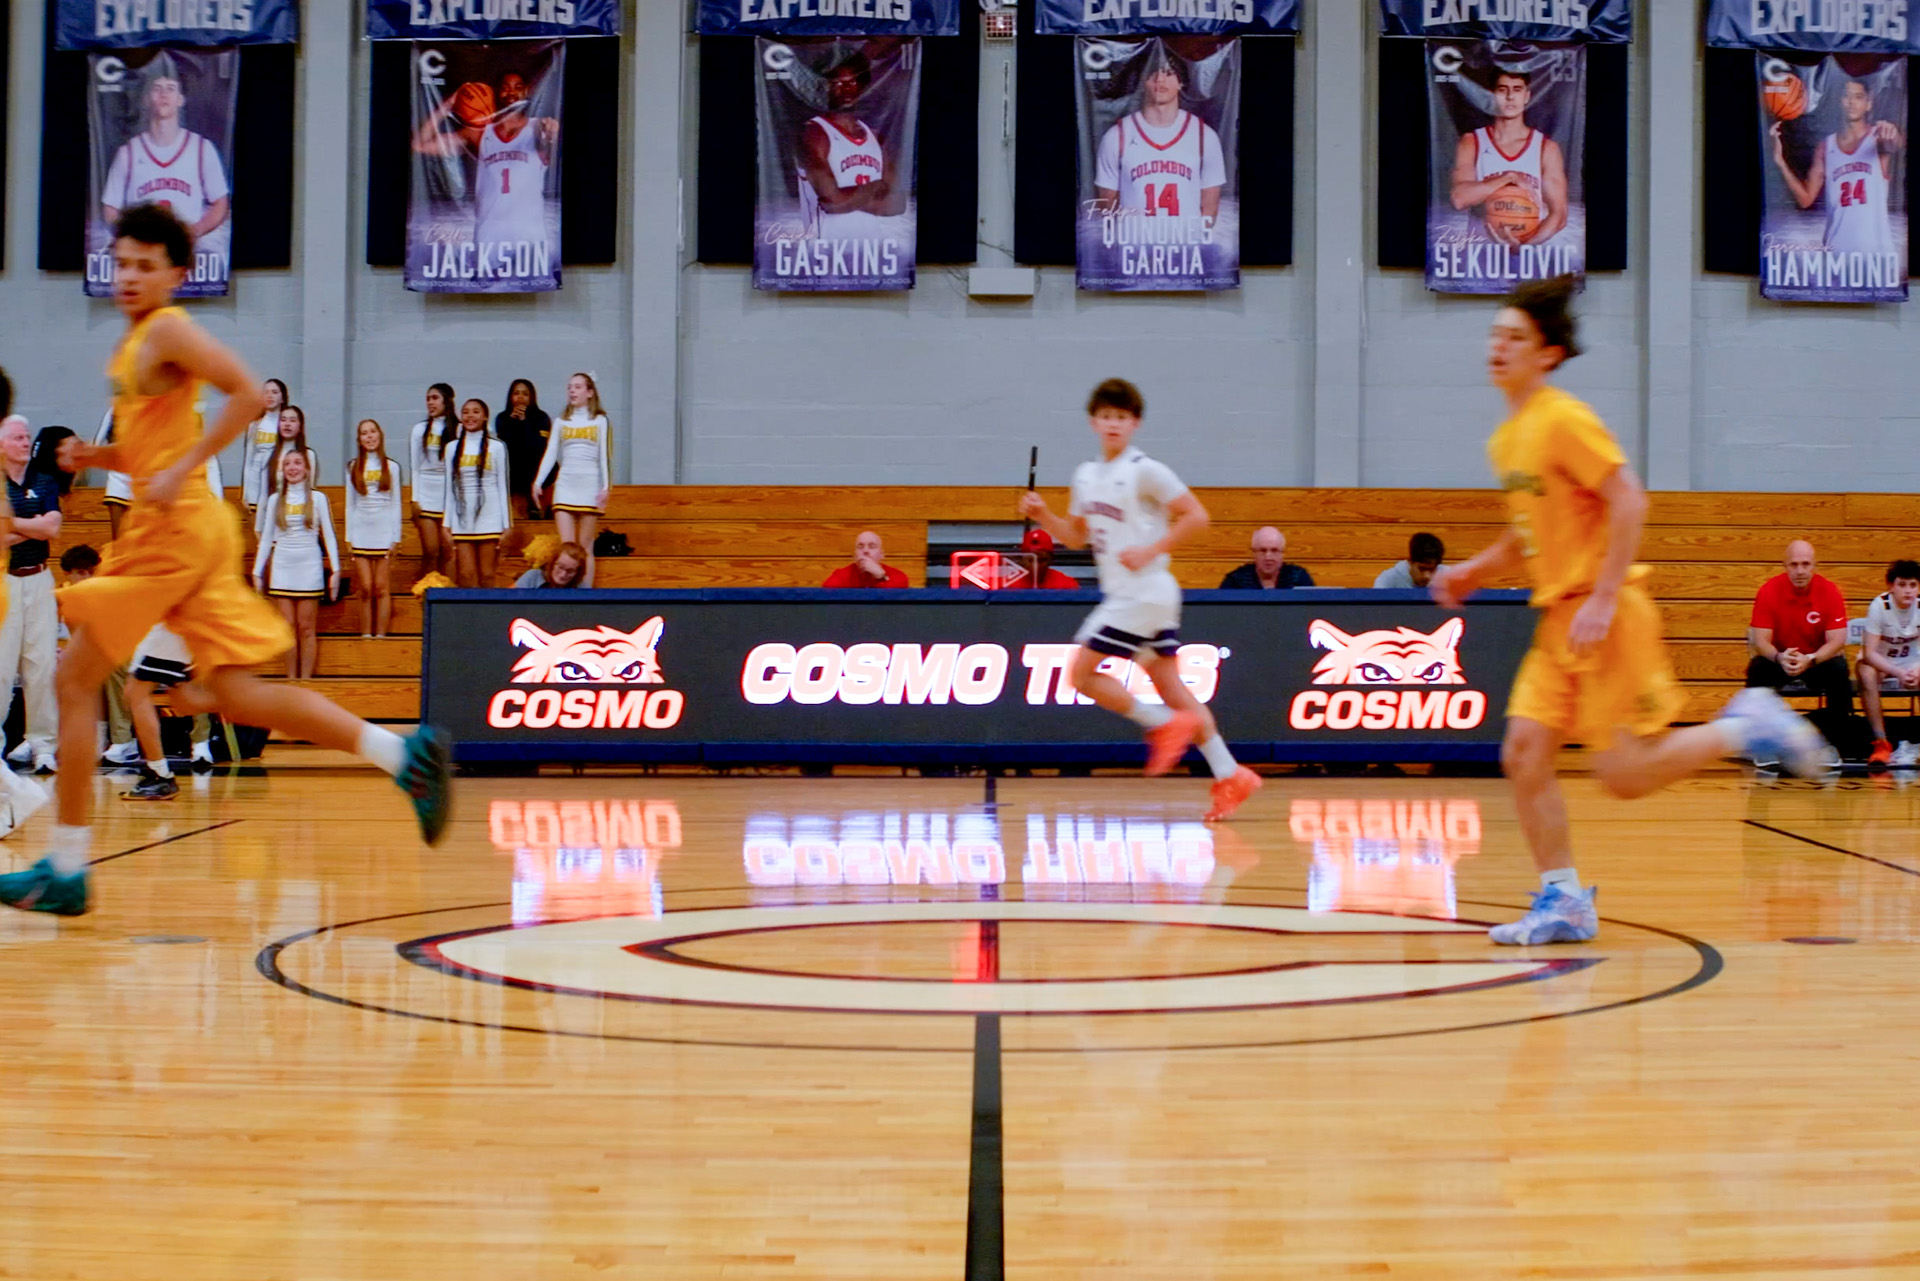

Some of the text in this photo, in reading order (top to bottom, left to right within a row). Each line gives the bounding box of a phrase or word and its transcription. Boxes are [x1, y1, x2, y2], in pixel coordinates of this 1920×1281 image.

[95, 0, 253, 37] EXPLORERS
[409, 0, 574, 25] EXPLORERS
[740, 0, 911, 22] EXPLORERS
[1083, 0, 1253, 23] EXPLORERS
[1422, 0, 1588, 29] EXPLORERS
[1751, 0, 1907, 41] EXPLORERS
[500, 168, 511, 194] 1
[1130, 160, 1192, 182] COLUMBUS
[1144, 183, 1180, 216] 14
[1840, 179, 1867, 207] 24
[423, 241, 549, 278] JACKSON
[776, 238, 898, 276] GASKINS
[1121, 245, 1205, 276] GARCIA
[1767, 251, 1900, 288] HAMMOND
[741, 642, 1009, 706] COSMO
[488, 688, 685, 729] COSMO
[1289, 690, 1487, 730] COSMO
